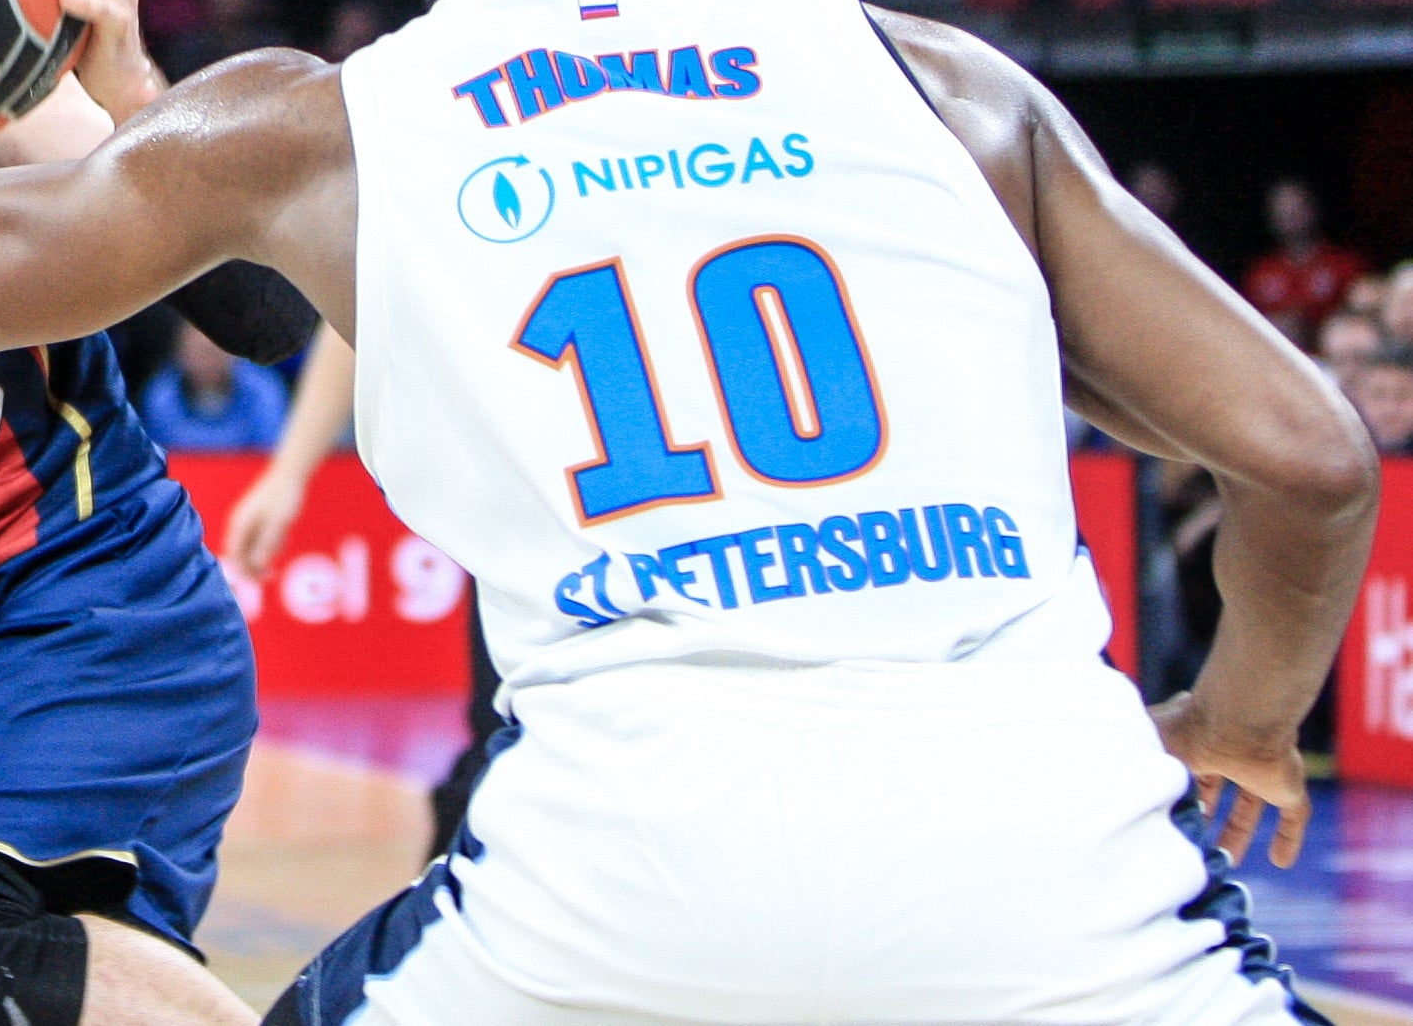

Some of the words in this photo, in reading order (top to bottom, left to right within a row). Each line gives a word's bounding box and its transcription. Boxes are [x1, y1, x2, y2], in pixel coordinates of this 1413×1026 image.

[452, 44, 761, 128] THOMAS
[571, 133, 815, 197] NIPIGAS
[508, 233, 890, 528] 10
[280, 534, 370, 624] el
[620, 503, 1031, 610] PETERSBURG
